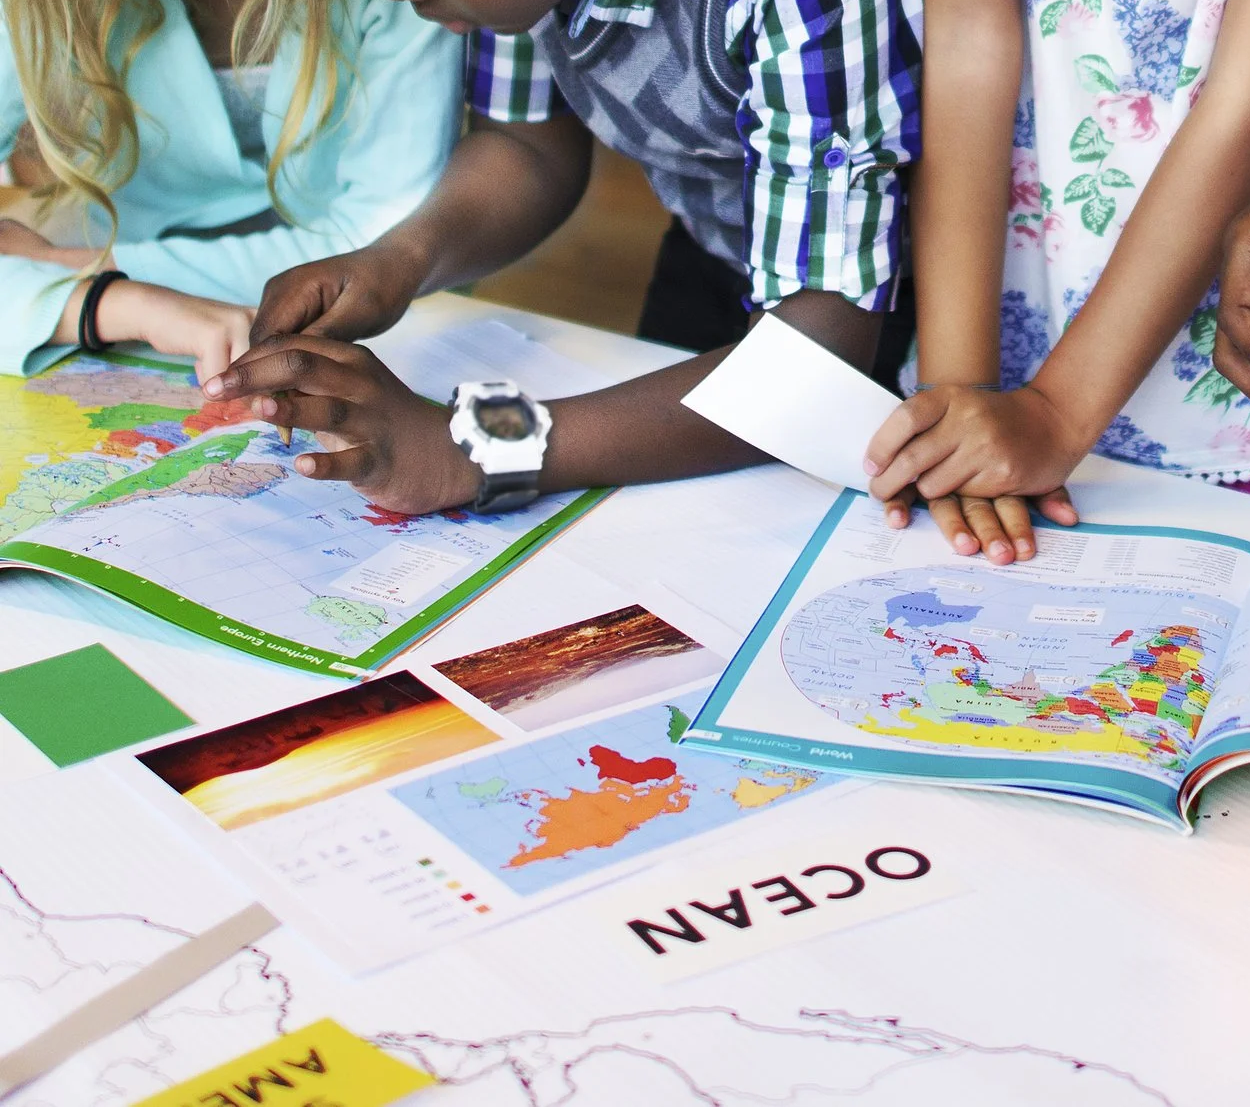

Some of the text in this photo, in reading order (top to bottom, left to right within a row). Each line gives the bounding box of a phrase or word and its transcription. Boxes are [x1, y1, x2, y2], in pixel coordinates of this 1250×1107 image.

[901, 605, 963, 619] AUSTRALIA
[219, 625, 325, 665] Northern Europe
[802, 678, 852, 690] PACIFIC
[811, 668, 855, 680] OCEAN
[955, 699, 1002, 707] CHINA
[732, 735, 854, 761] World Countries
[626, 847, 931, 956] OCEAN
[188, 1049, 327, 1106] AME
